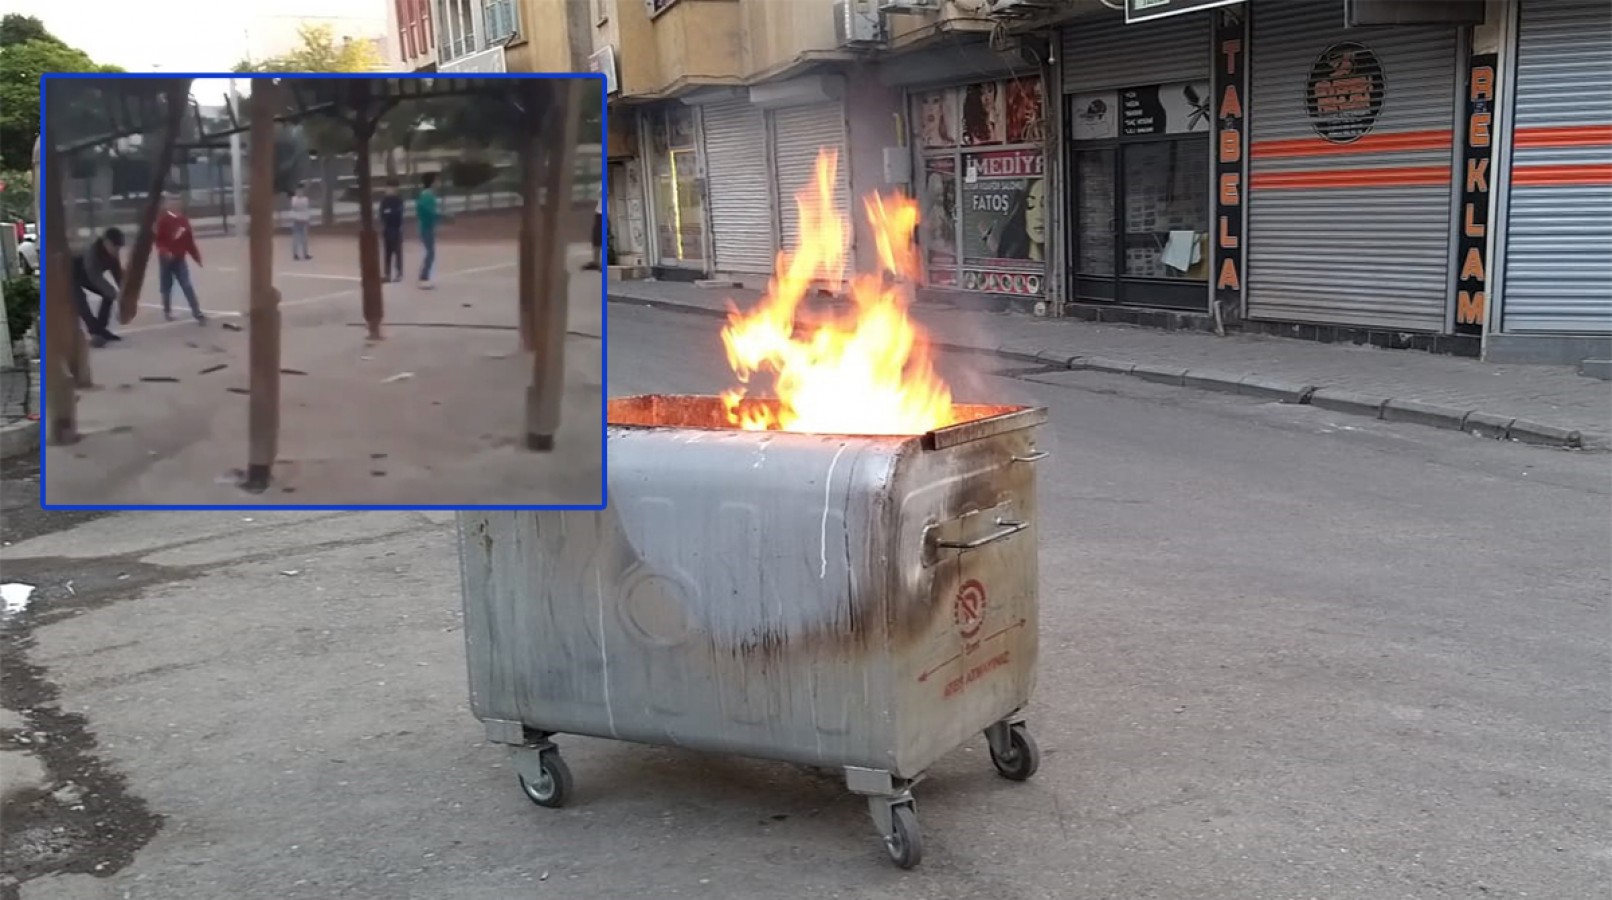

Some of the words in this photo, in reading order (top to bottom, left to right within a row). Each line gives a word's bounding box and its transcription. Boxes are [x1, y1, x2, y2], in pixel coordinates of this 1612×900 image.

[973, 194, 1009, 216] FATOŞ
[1217, 40, 1242, 290] TABELA
[1457, 66, 1494, 325] REKLAM
